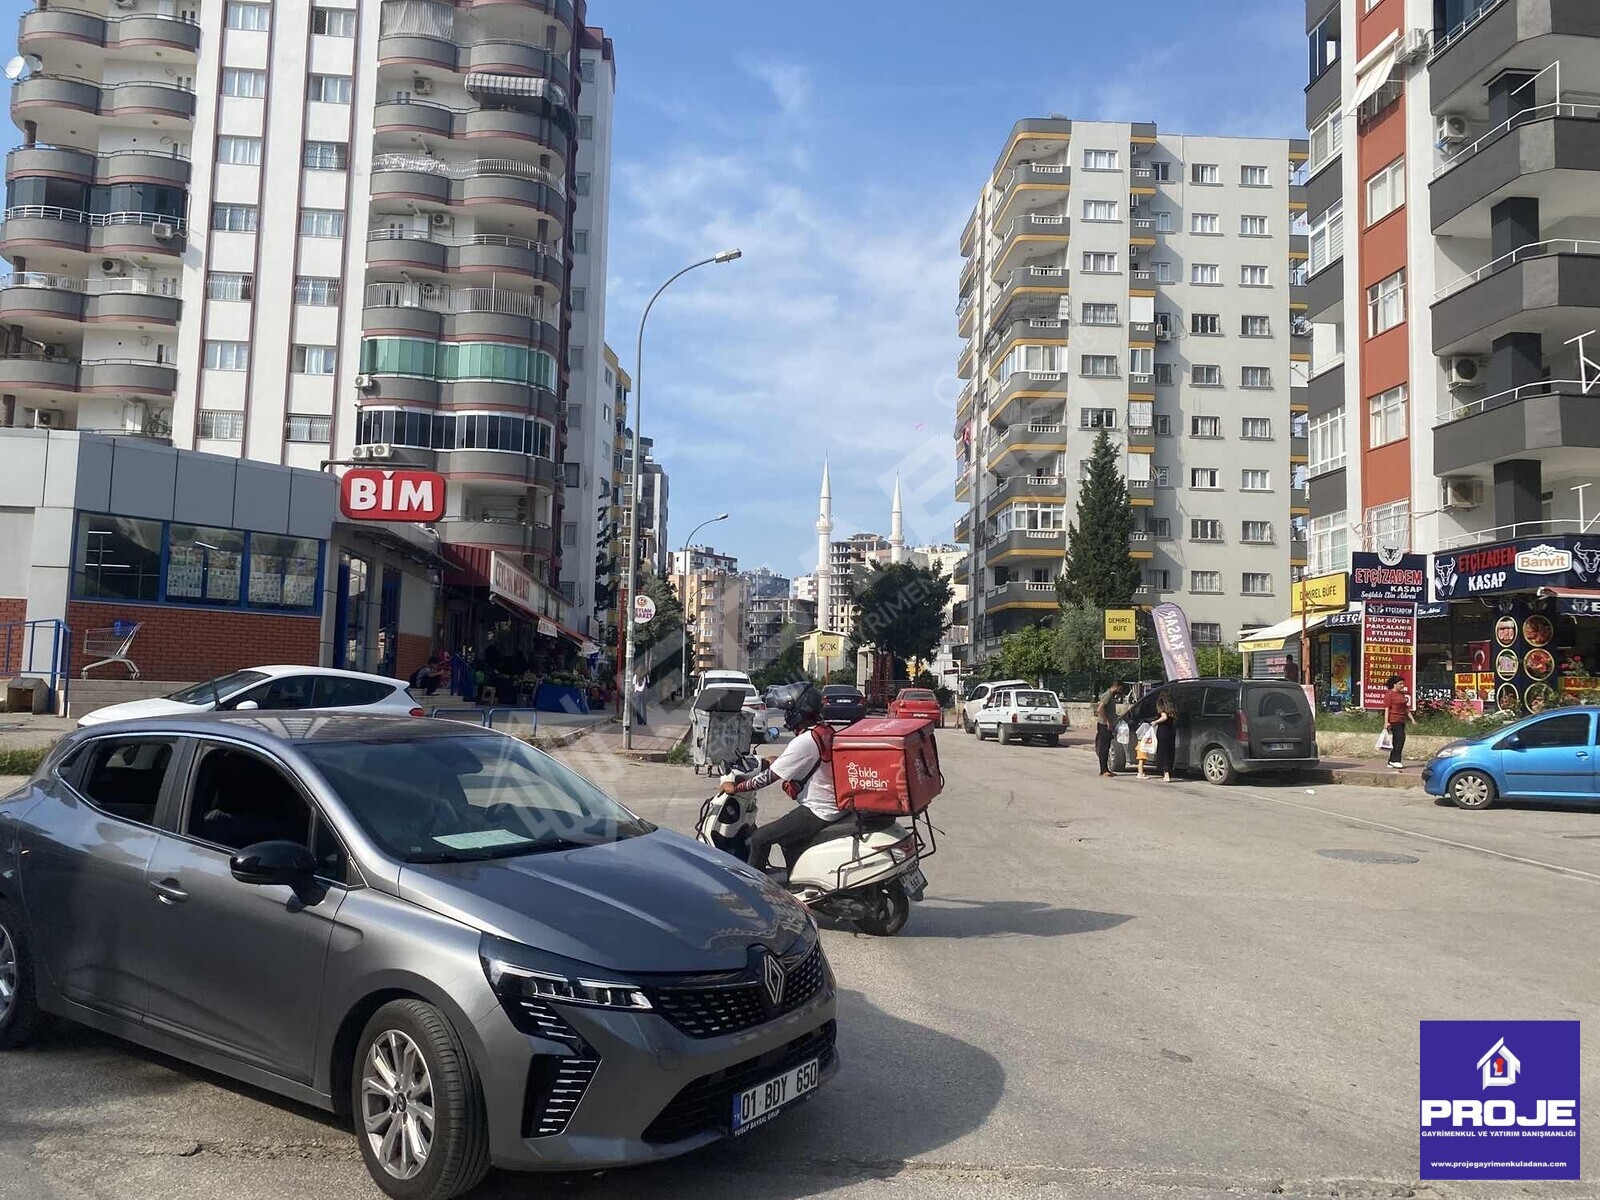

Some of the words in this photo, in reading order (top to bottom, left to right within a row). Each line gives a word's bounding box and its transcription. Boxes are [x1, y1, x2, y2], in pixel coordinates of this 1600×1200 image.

[350, 471, 434, 512] BİM
[1459, 546, 1516, 574] ETÇİZADEM
[1521, 555, 1565, 568] Banvit
[1355, 566, 1422, 587] ETÇİZADEM
[1468, 572, 1506, 591] KASAP
[1300, 588, 1321, 601] DMİREL
[860, 778, 888, 790] gelsin
[742, 1090, 757, 1121] 01
[765, 1075, 788, 1111] BDY
[796, 1061, 817, 1094] 650
